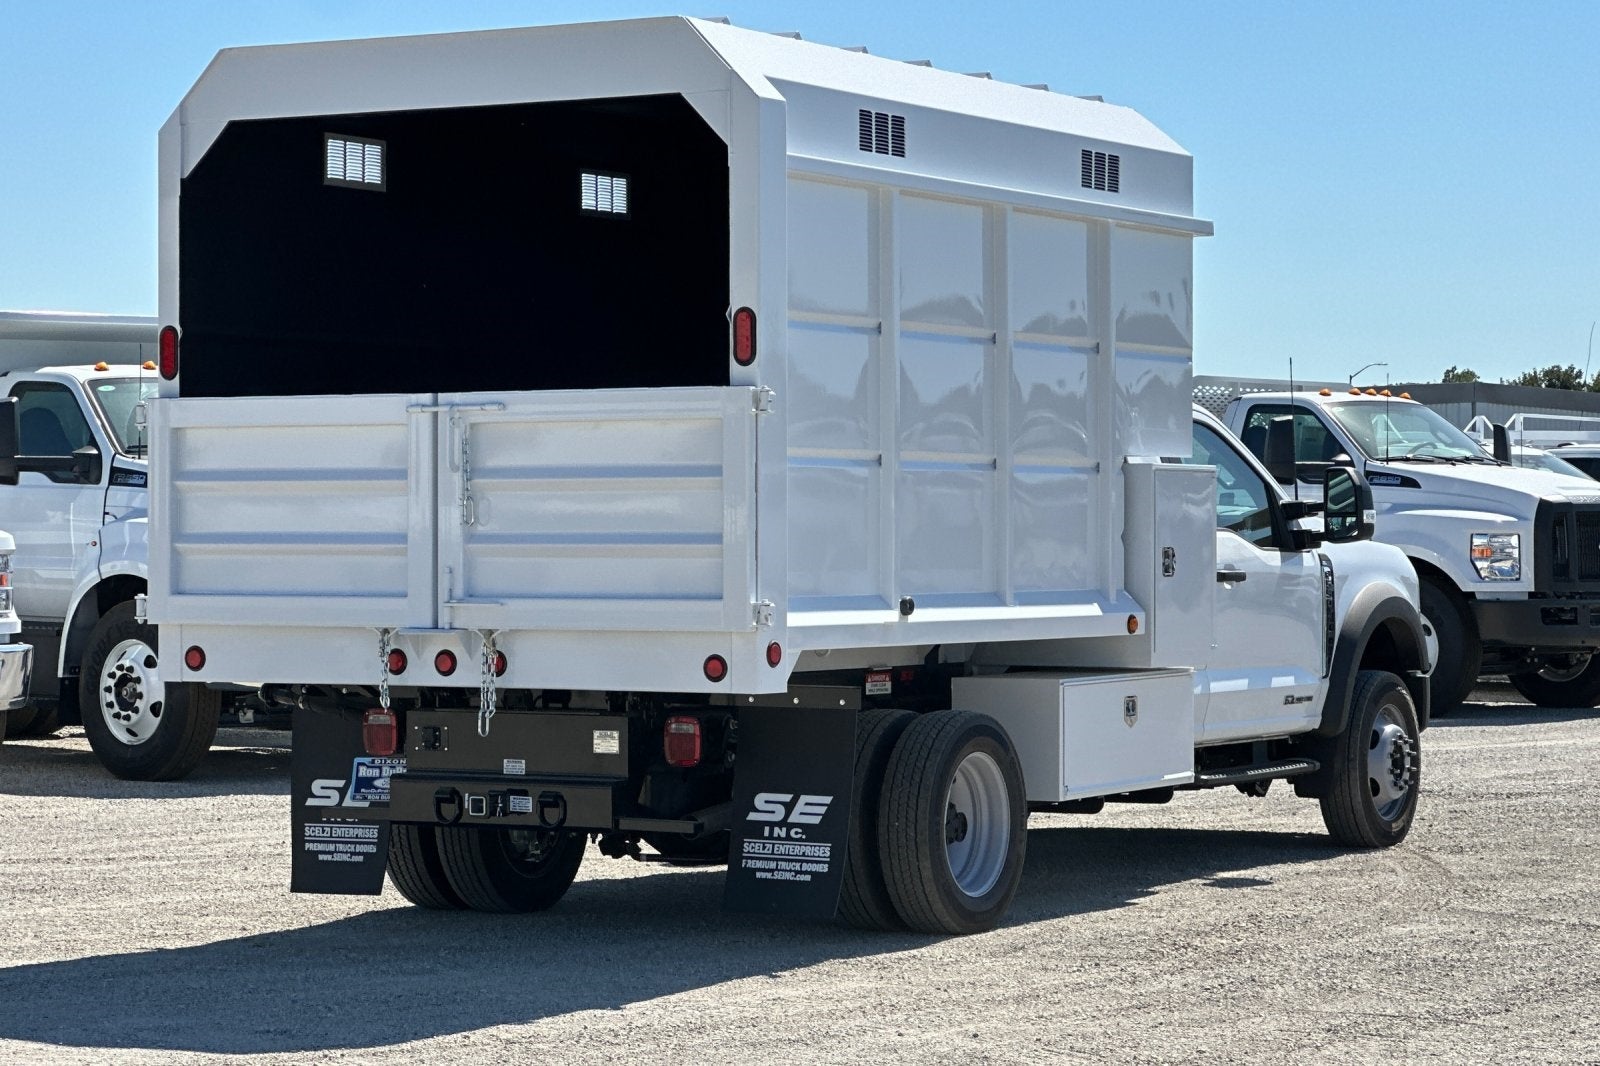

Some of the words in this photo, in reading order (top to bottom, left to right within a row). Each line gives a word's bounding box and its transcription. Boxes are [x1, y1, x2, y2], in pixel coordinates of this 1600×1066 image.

[358, 765, 380, 778] Ron
[745, 792, 834, 824] SE
[304, 826, 331, 837] SCELZI
[332, 827, 379, 839] ENTERPRISES
[763, 826, 806, 839] INC.
[305, 842, 335, 852] PREMIUM
[336, 843, 355, 852] TRUCK
[355, 844, 377, 853] BODIES
[742, 842, 773, 854] SCELZI
[774, 844, 831, 857] ENTERPRISES
[777, 861, 801, 871] TRUCK
[801, 862, 829, 873] BODIES
